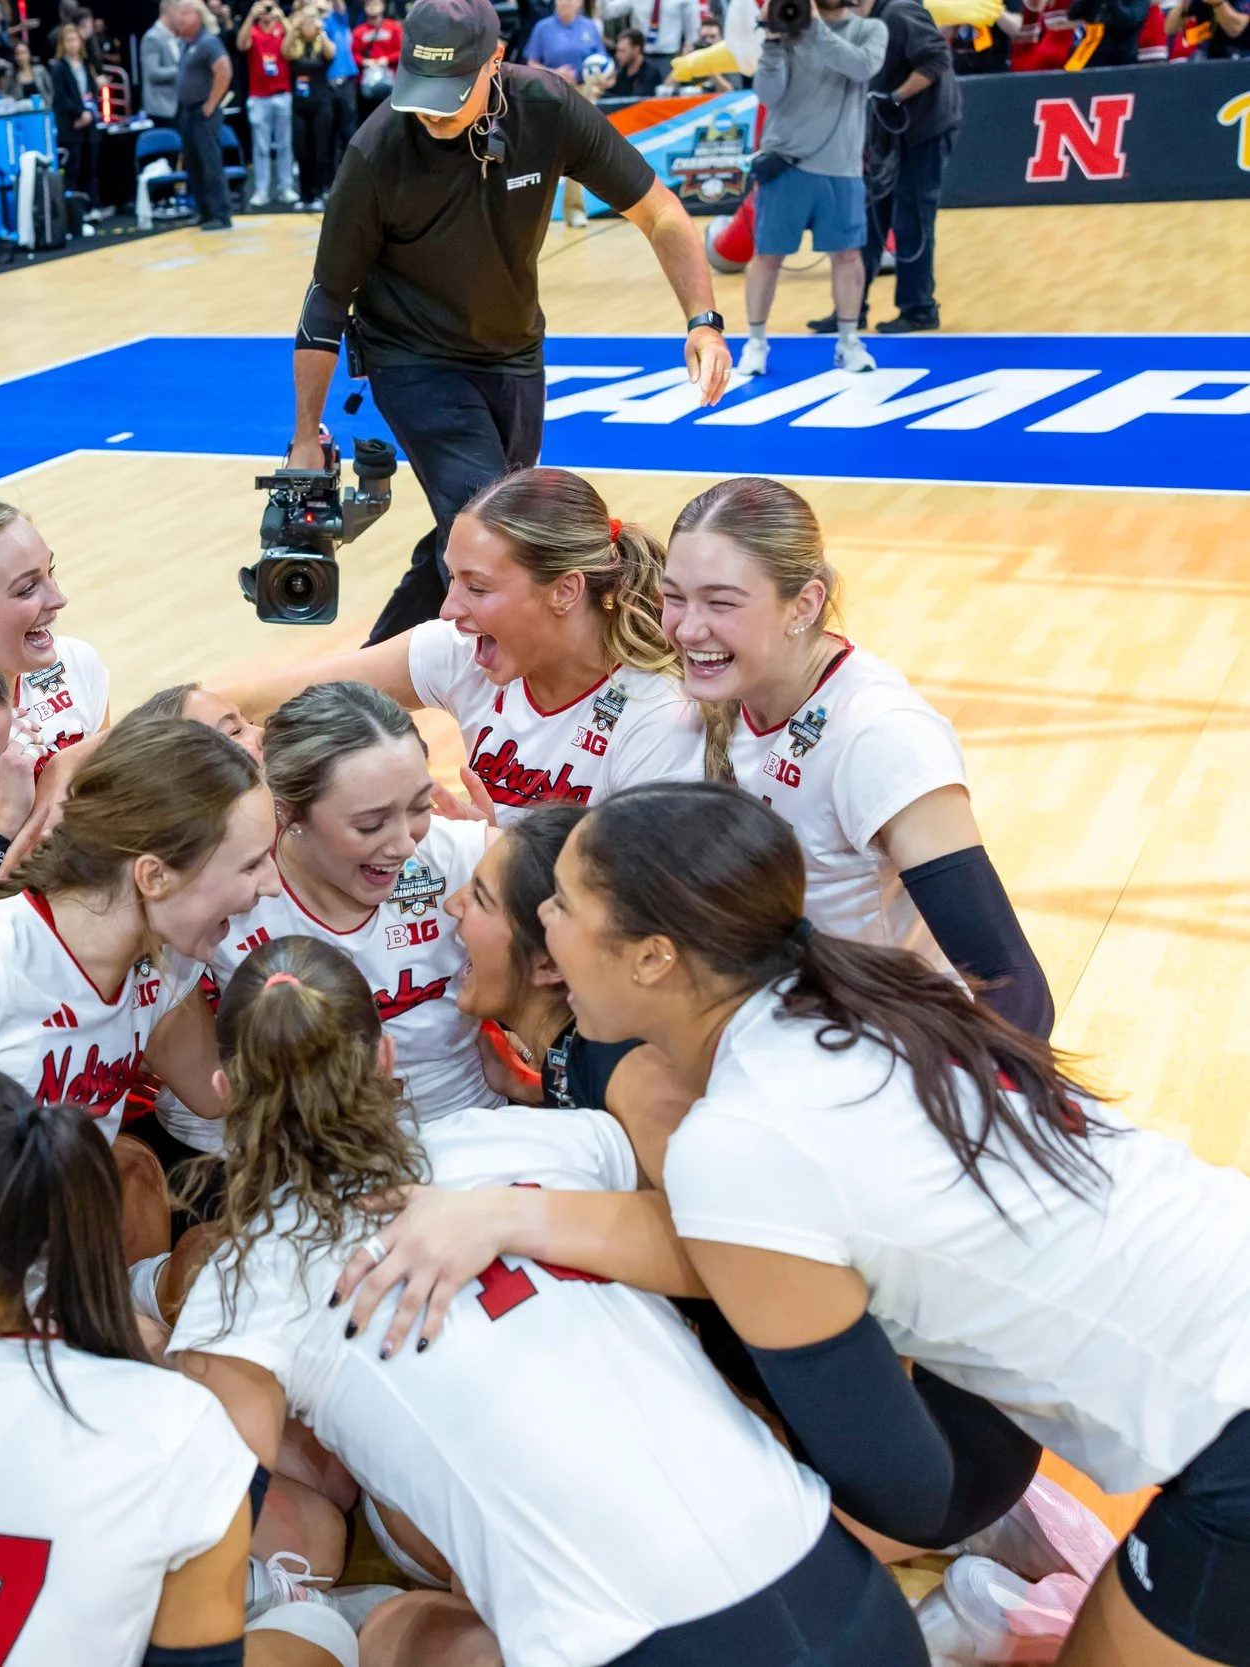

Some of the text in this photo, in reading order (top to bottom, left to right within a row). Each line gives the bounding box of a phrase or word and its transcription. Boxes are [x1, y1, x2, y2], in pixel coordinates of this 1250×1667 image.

[413, 44, 454, 61] ESPN
[1026, 93, 1135, 183] N
[507, 172, 541, 190] ESPN
[469, 726, 593, 806] ebraska
[399, 880, 430, 889] VOLLEYBALL
